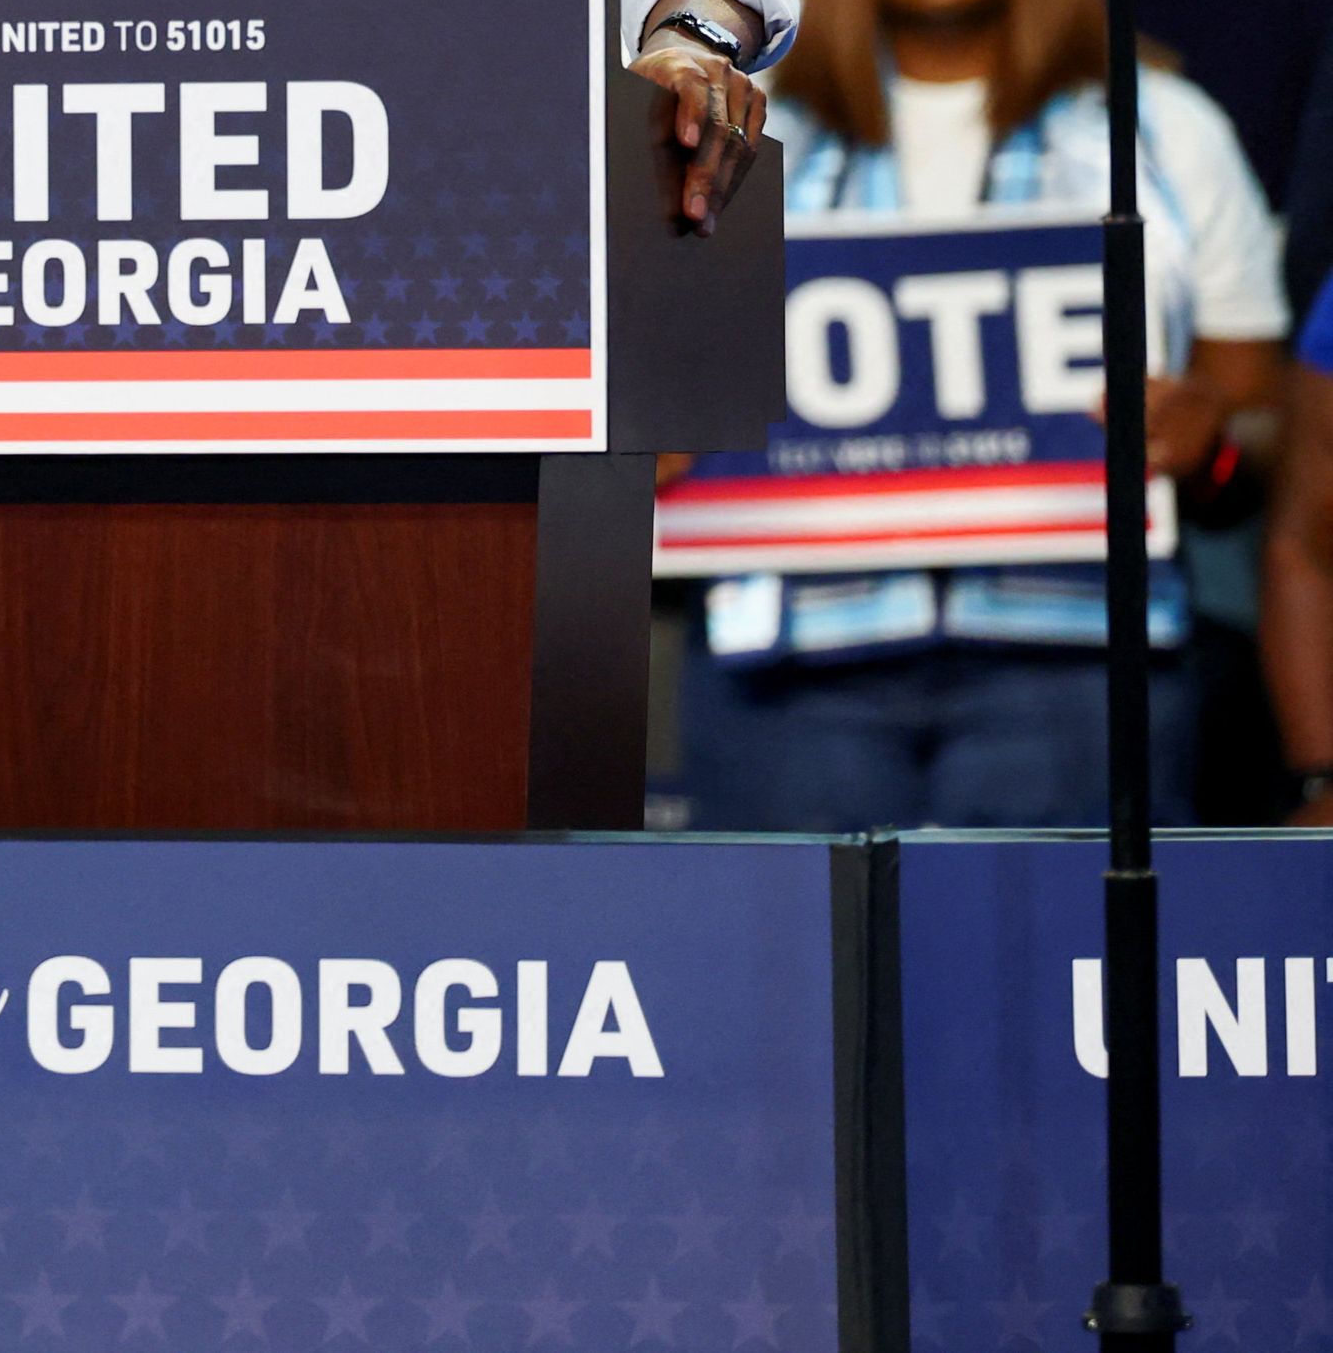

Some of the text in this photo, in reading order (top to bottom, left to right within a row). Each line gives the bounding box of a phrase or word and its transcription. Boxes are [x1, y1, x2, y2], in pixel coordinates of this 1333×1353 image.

[113, 20, 157, 52] TO
[166, 19, 266, 51] 51015
[783, 261, 1105, 429] OTE
[27, 955, 665, 1078] GEORGIA
